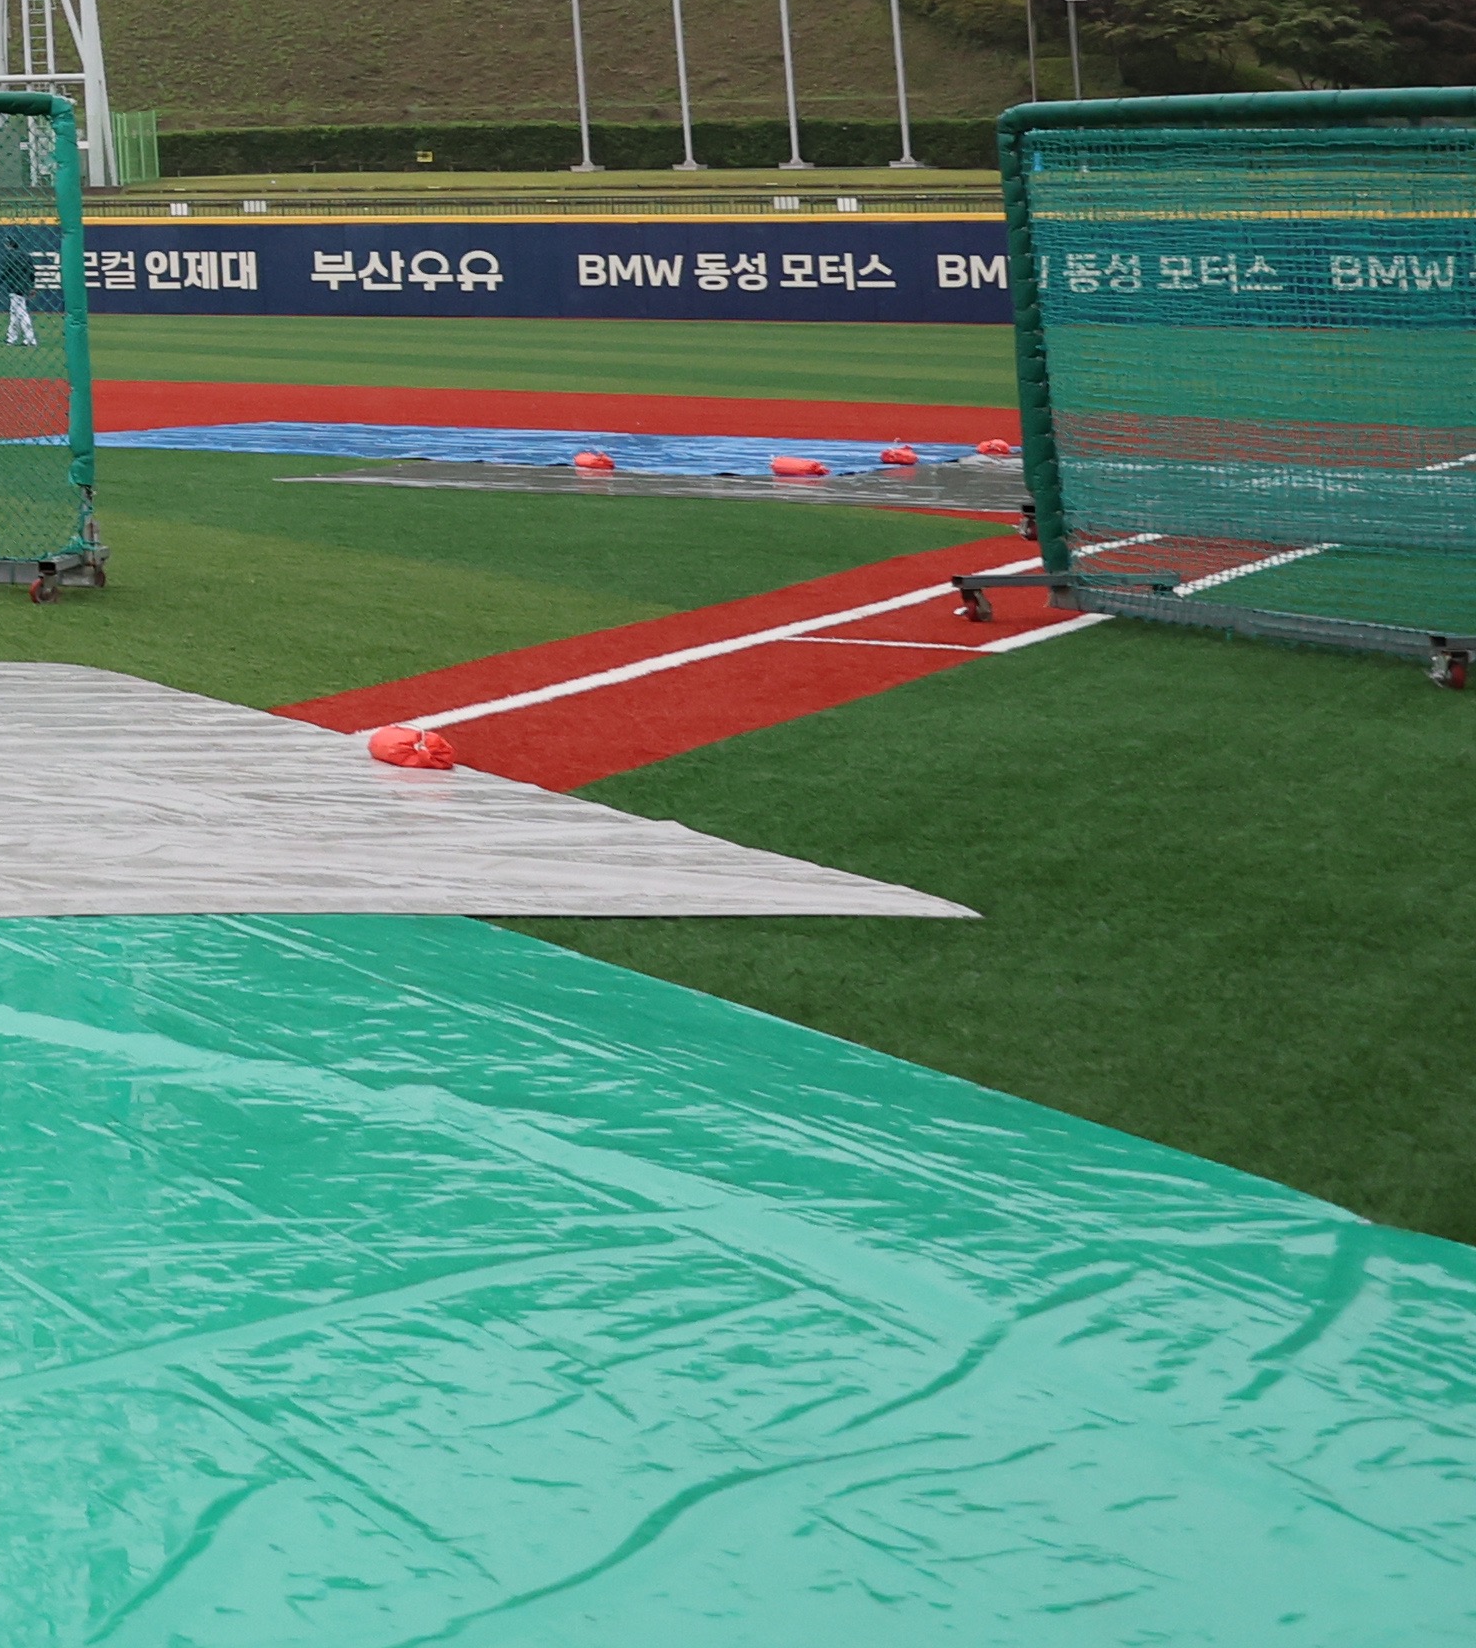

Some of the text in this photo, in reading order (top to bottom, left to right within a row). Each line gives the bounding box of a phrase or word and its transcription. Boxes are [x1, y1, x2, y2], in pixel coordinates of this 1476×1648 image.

[144, 251, 259, 290] 인제대
[310, 250, 504, 291] 부산우유
[577, 252, 897, 291] BMW 동성 모터스
[937, 254, 1049, 290] BM
